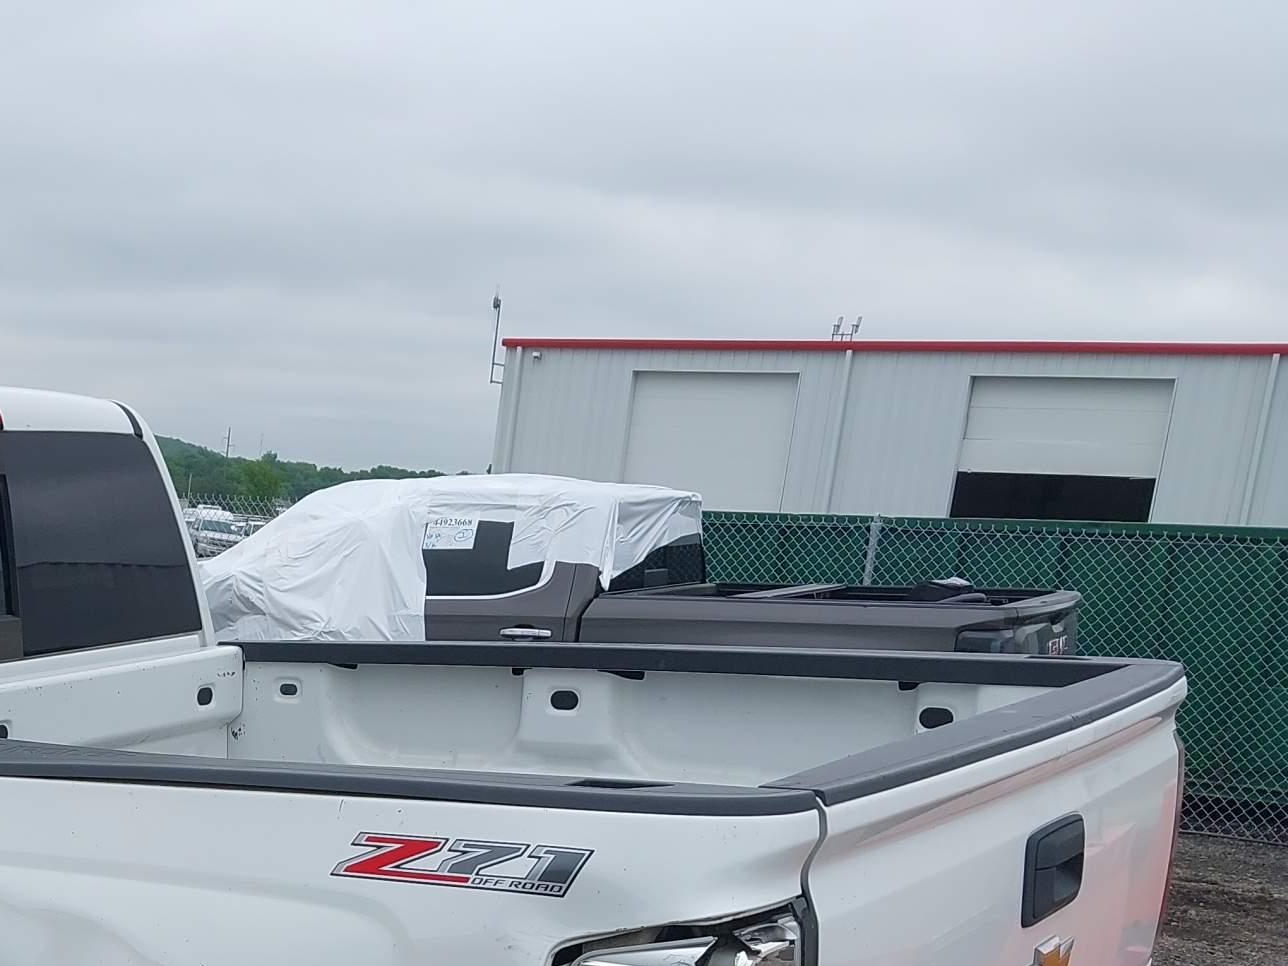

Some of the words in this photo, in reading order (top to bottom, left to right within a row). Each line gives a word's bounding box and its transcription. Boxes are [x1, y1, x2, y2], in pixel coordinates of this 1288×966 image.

[330, 832, 595, 889] Z71
[470, 876, 507, 888] OFF
[508, 881, 565, 893] ROAD
